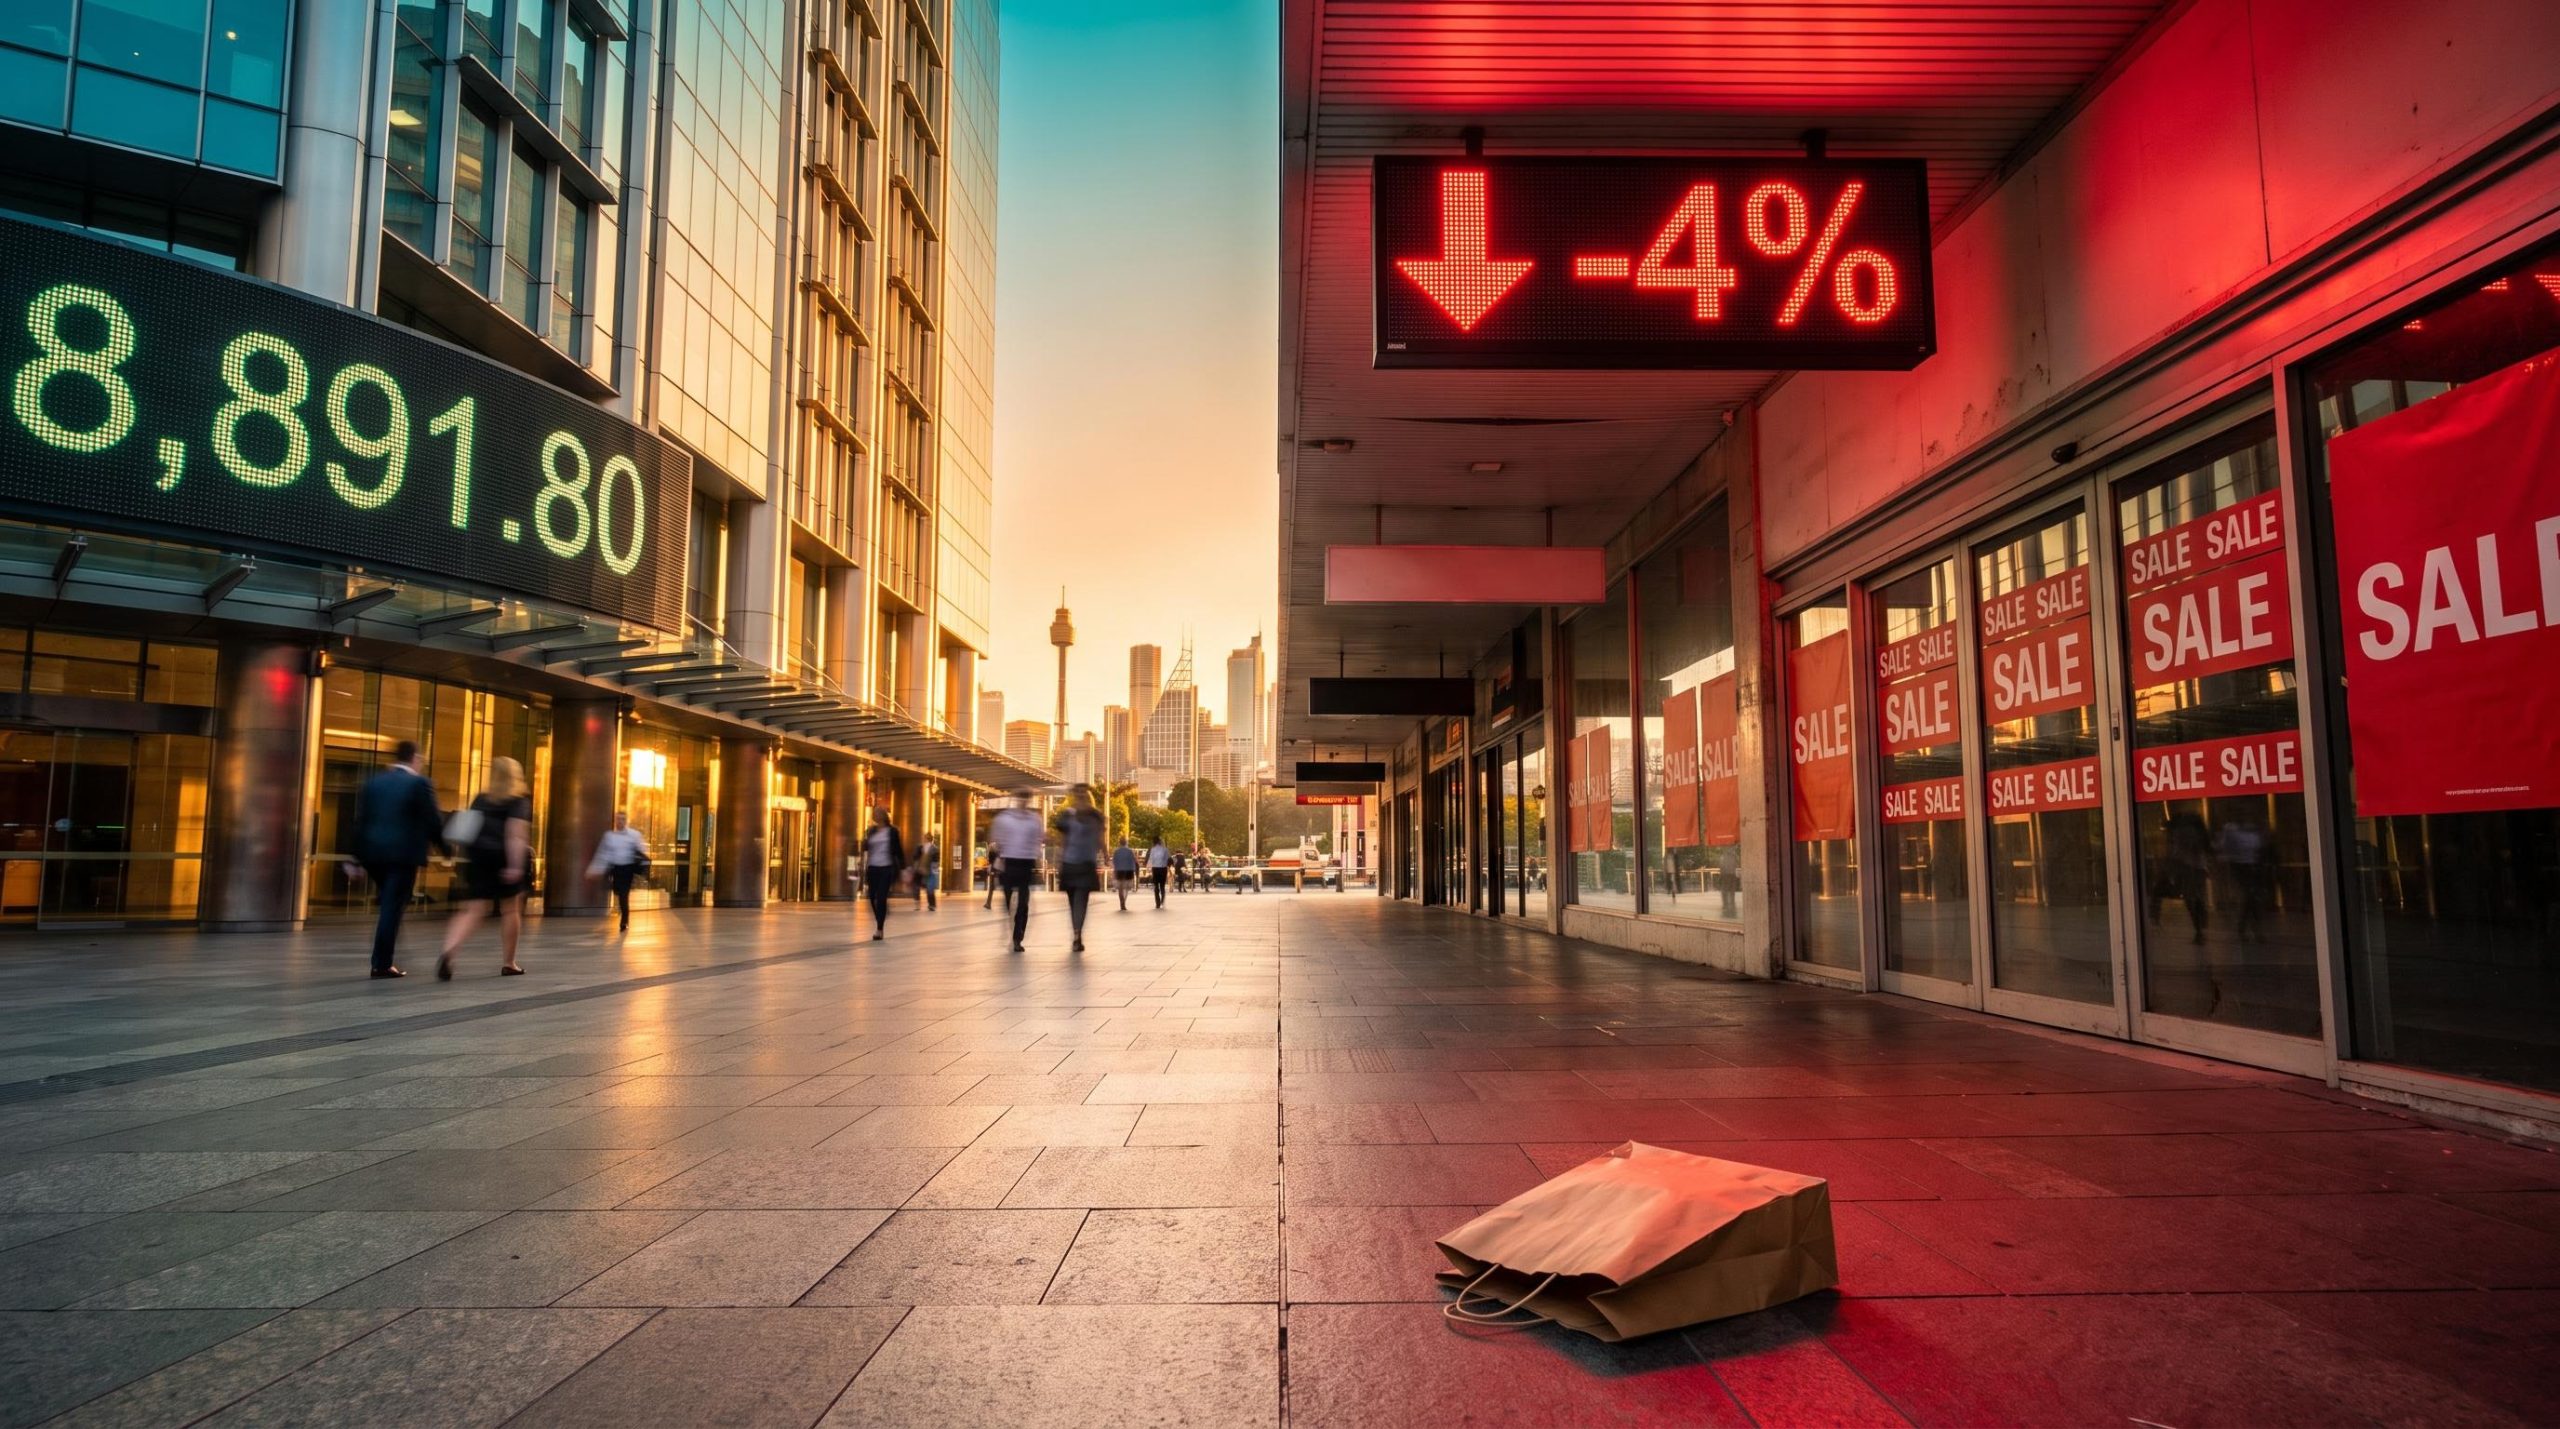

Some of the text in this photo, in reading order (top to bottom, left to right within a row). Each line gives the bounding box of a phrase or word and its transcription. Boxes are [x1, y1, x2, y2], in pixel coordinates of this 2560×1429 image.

[1574, 182, 1897, 325] -4%
[13, 283, 645, 576] 8,891.80
[2132, 500, 2278, 584] SALE SALE
[1984, 574, 2083, 637] SALE SALE
[2143, 572, 2273, 672] SALE
[1880, 629, 1953, 679] SALE SALE
[1993, 633, 2082, 711] SALE
[1794, 703, 1849, 764] SALE
[1886, 680, 1951, 743] SALE
[1665, 747, 1696, 789] SALE
[1992, 765, 2095, 808] SALE SALE
[2143, 741, 2297, 793] SALE SALE
[1885, 783, 1961, 818] SALE SALE
